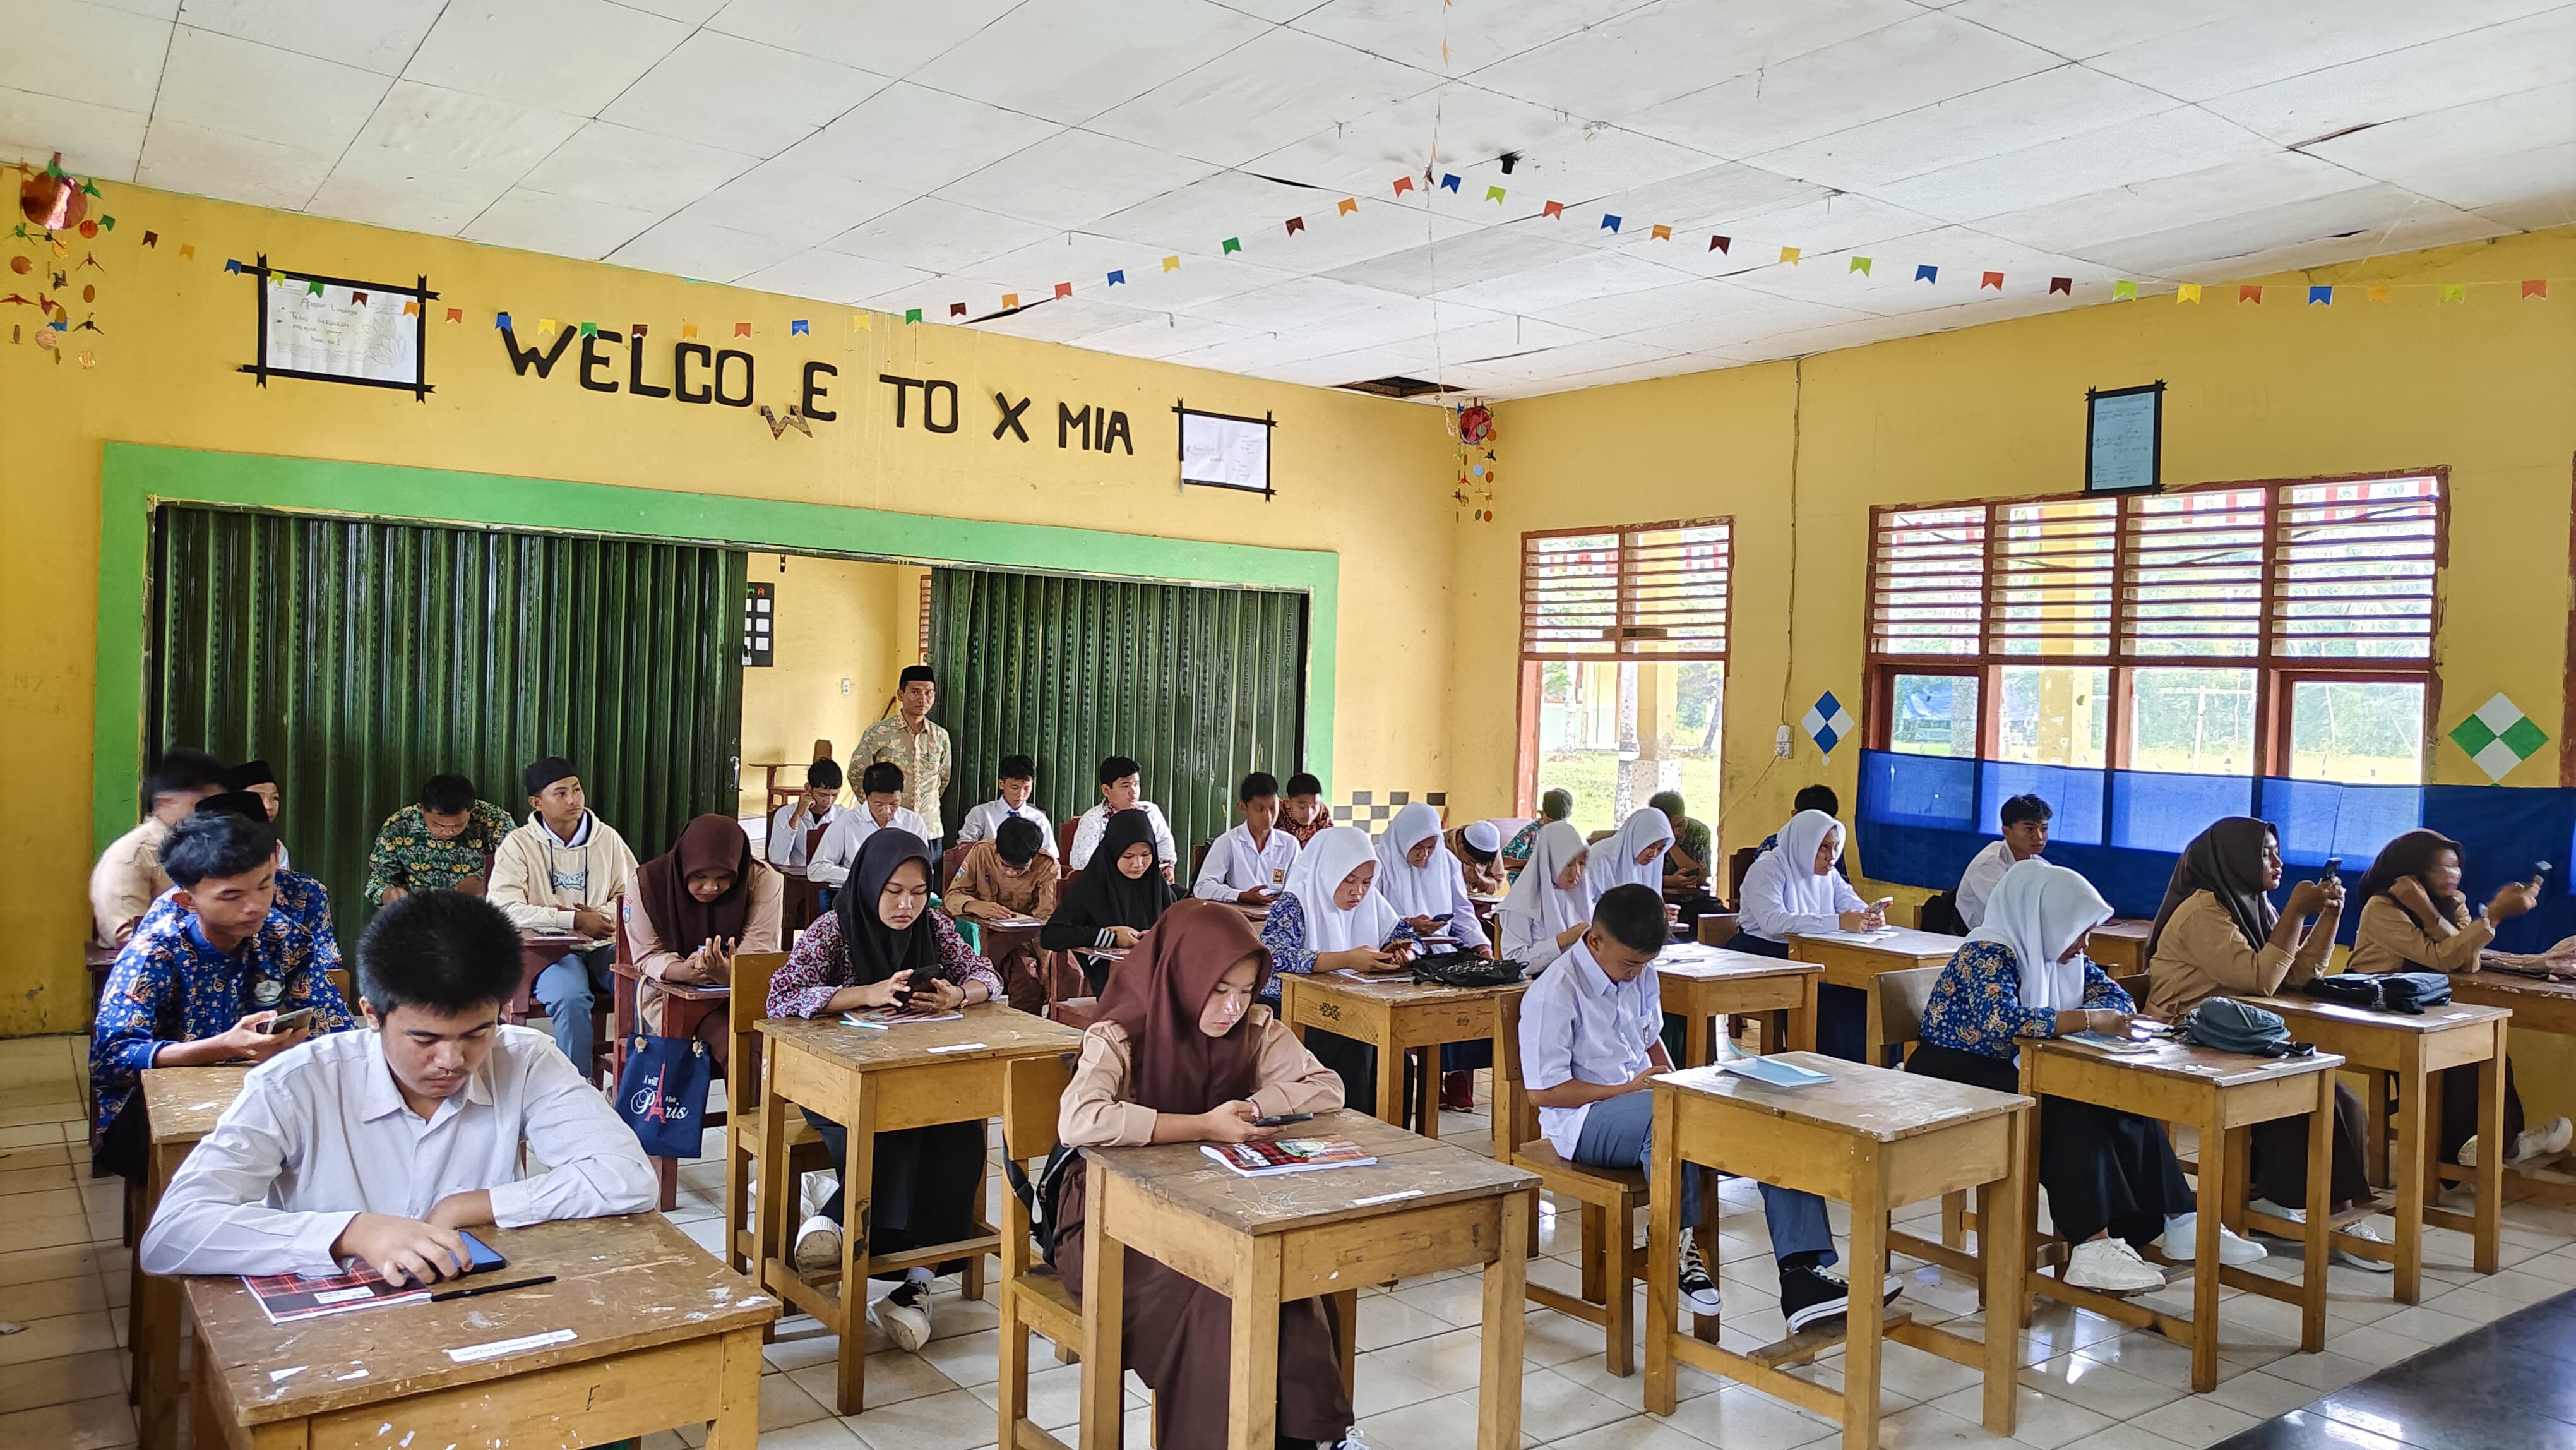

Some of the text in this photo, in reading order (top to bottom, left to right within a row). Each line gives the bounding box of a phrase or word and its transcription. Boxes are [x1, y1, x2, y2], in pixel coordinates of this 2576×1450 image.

[879, 374, 958, 434] TO
[992, 392, 1031, 443] X
[1058, 402, 1134, 455] MIA
[643, 1075, 648, 1084] I
